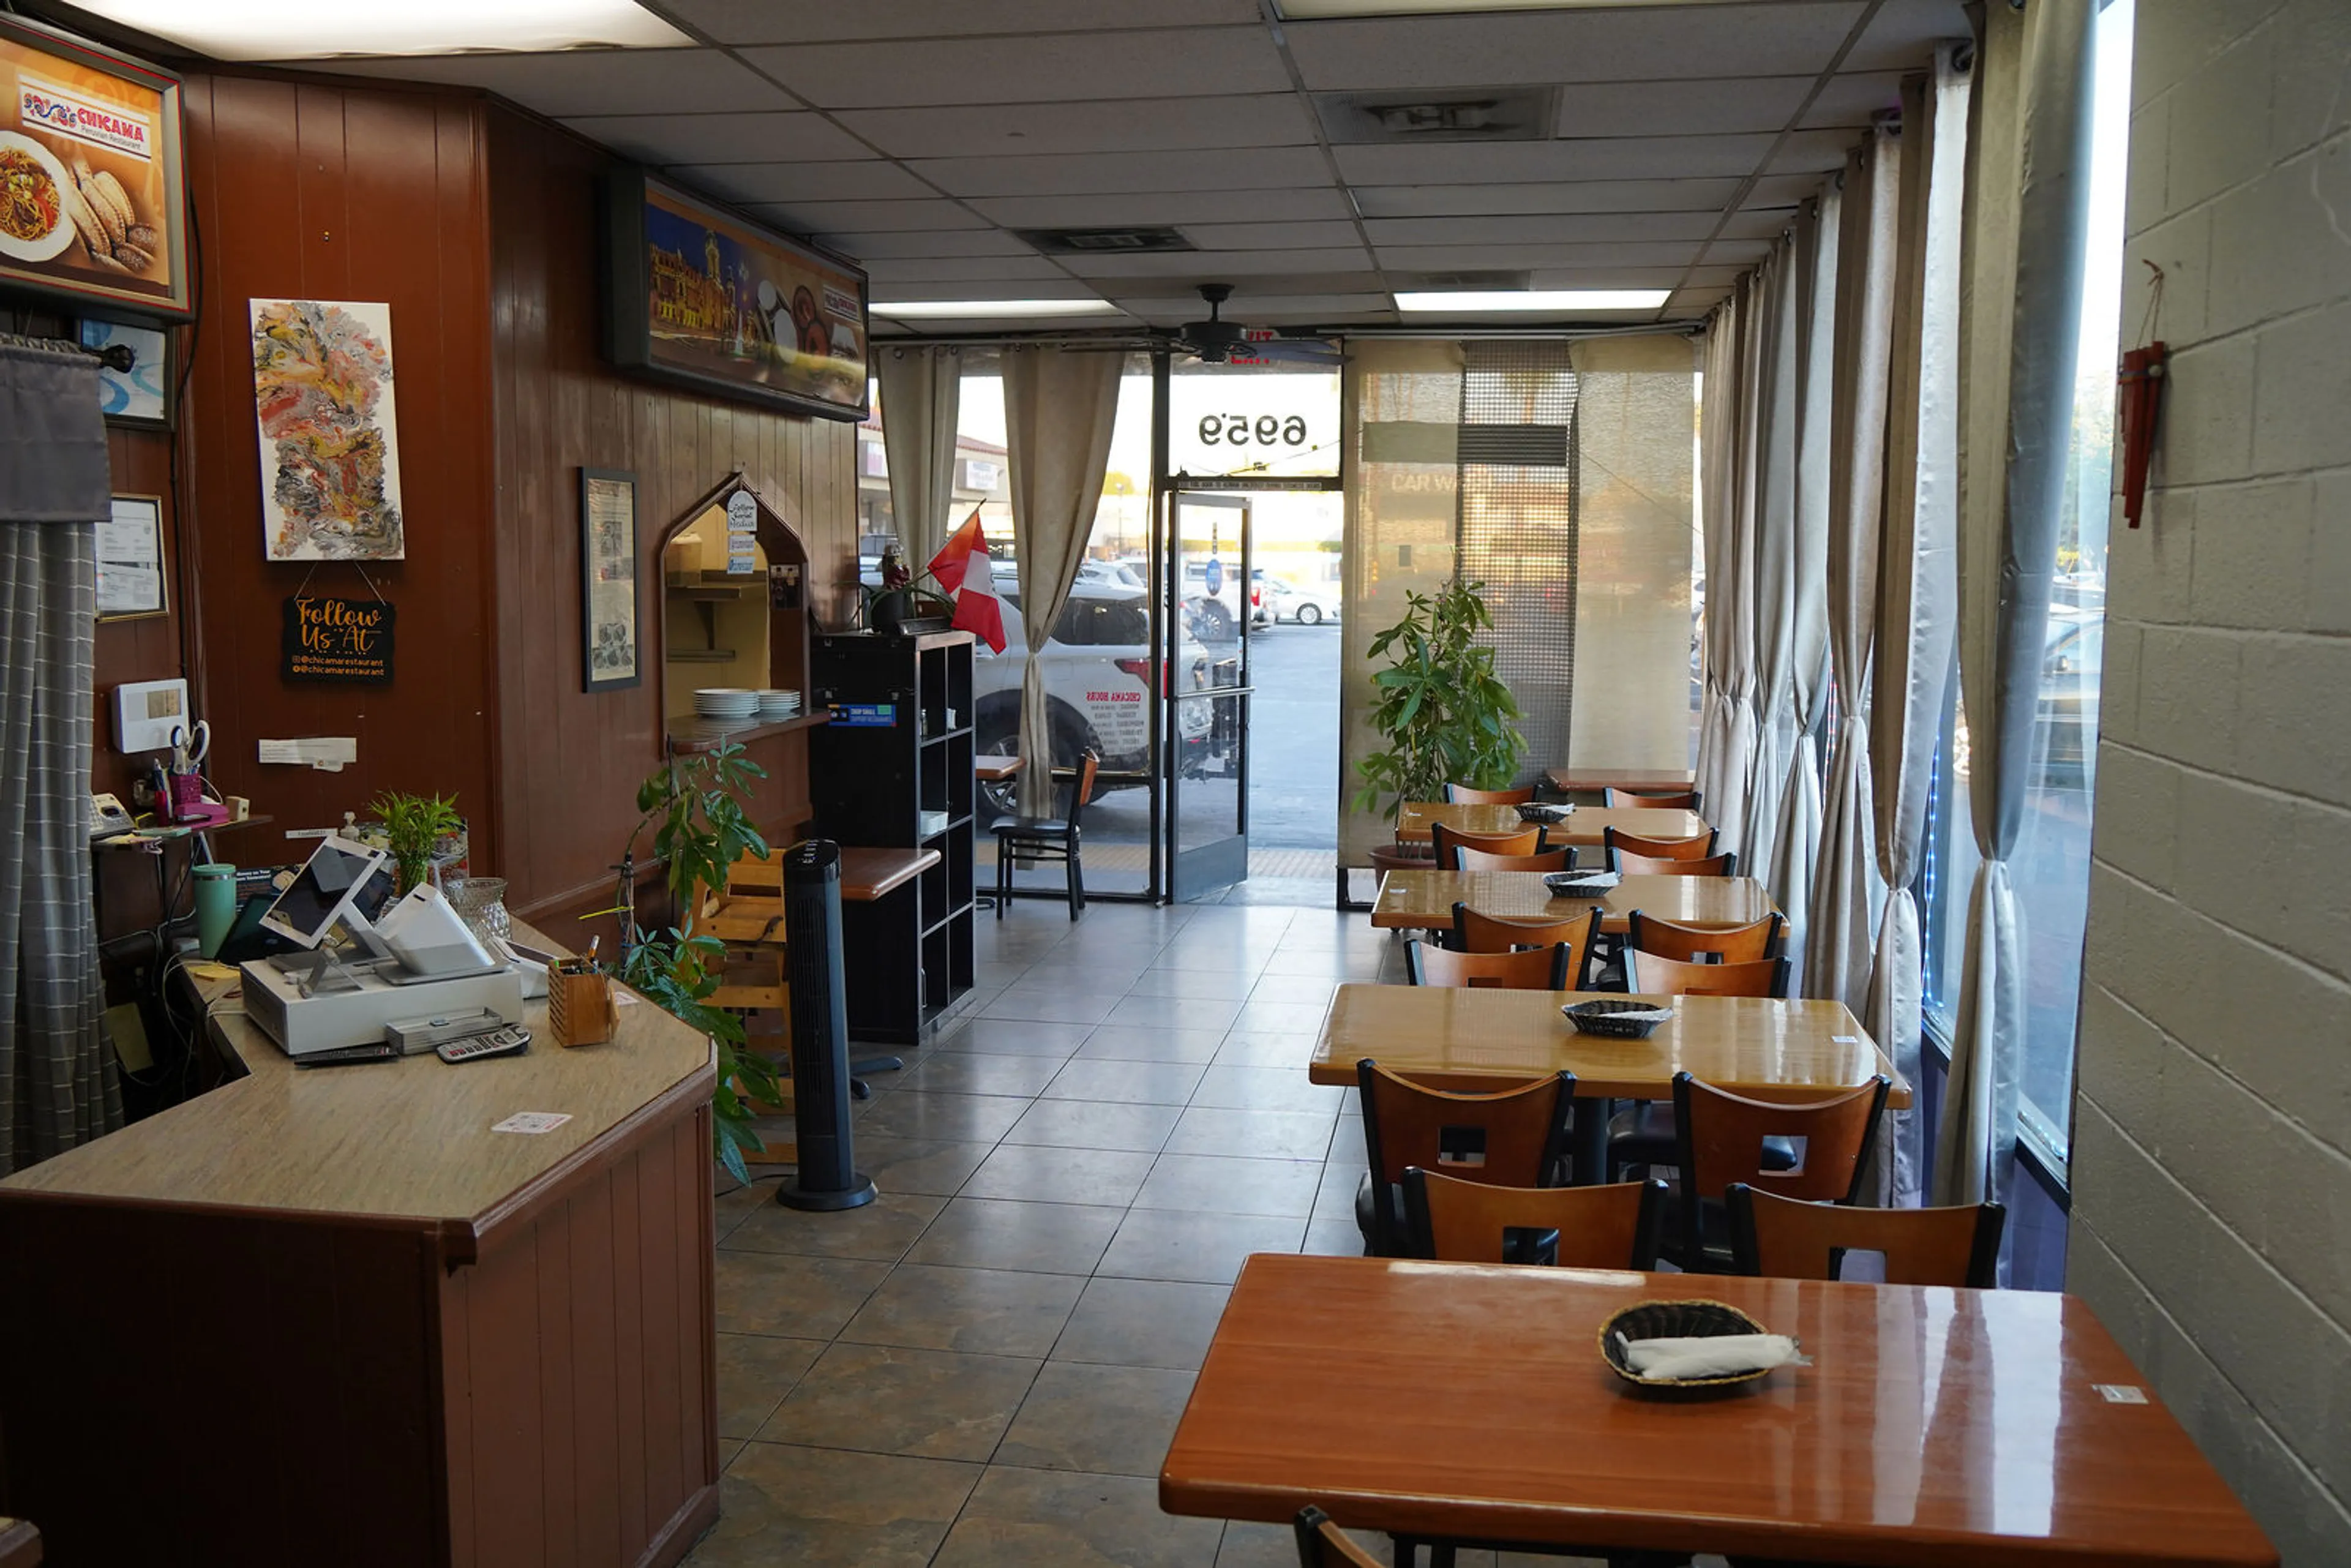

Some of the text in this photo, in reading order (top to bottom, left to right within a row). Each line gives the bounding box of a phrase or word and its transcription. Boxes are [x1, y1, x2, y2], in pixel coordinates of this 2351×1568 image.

[78, 108, 144, 141] CHICAMA
[296, 597, 383, 627] Follow
[301, 624, 382, 652] Us At
